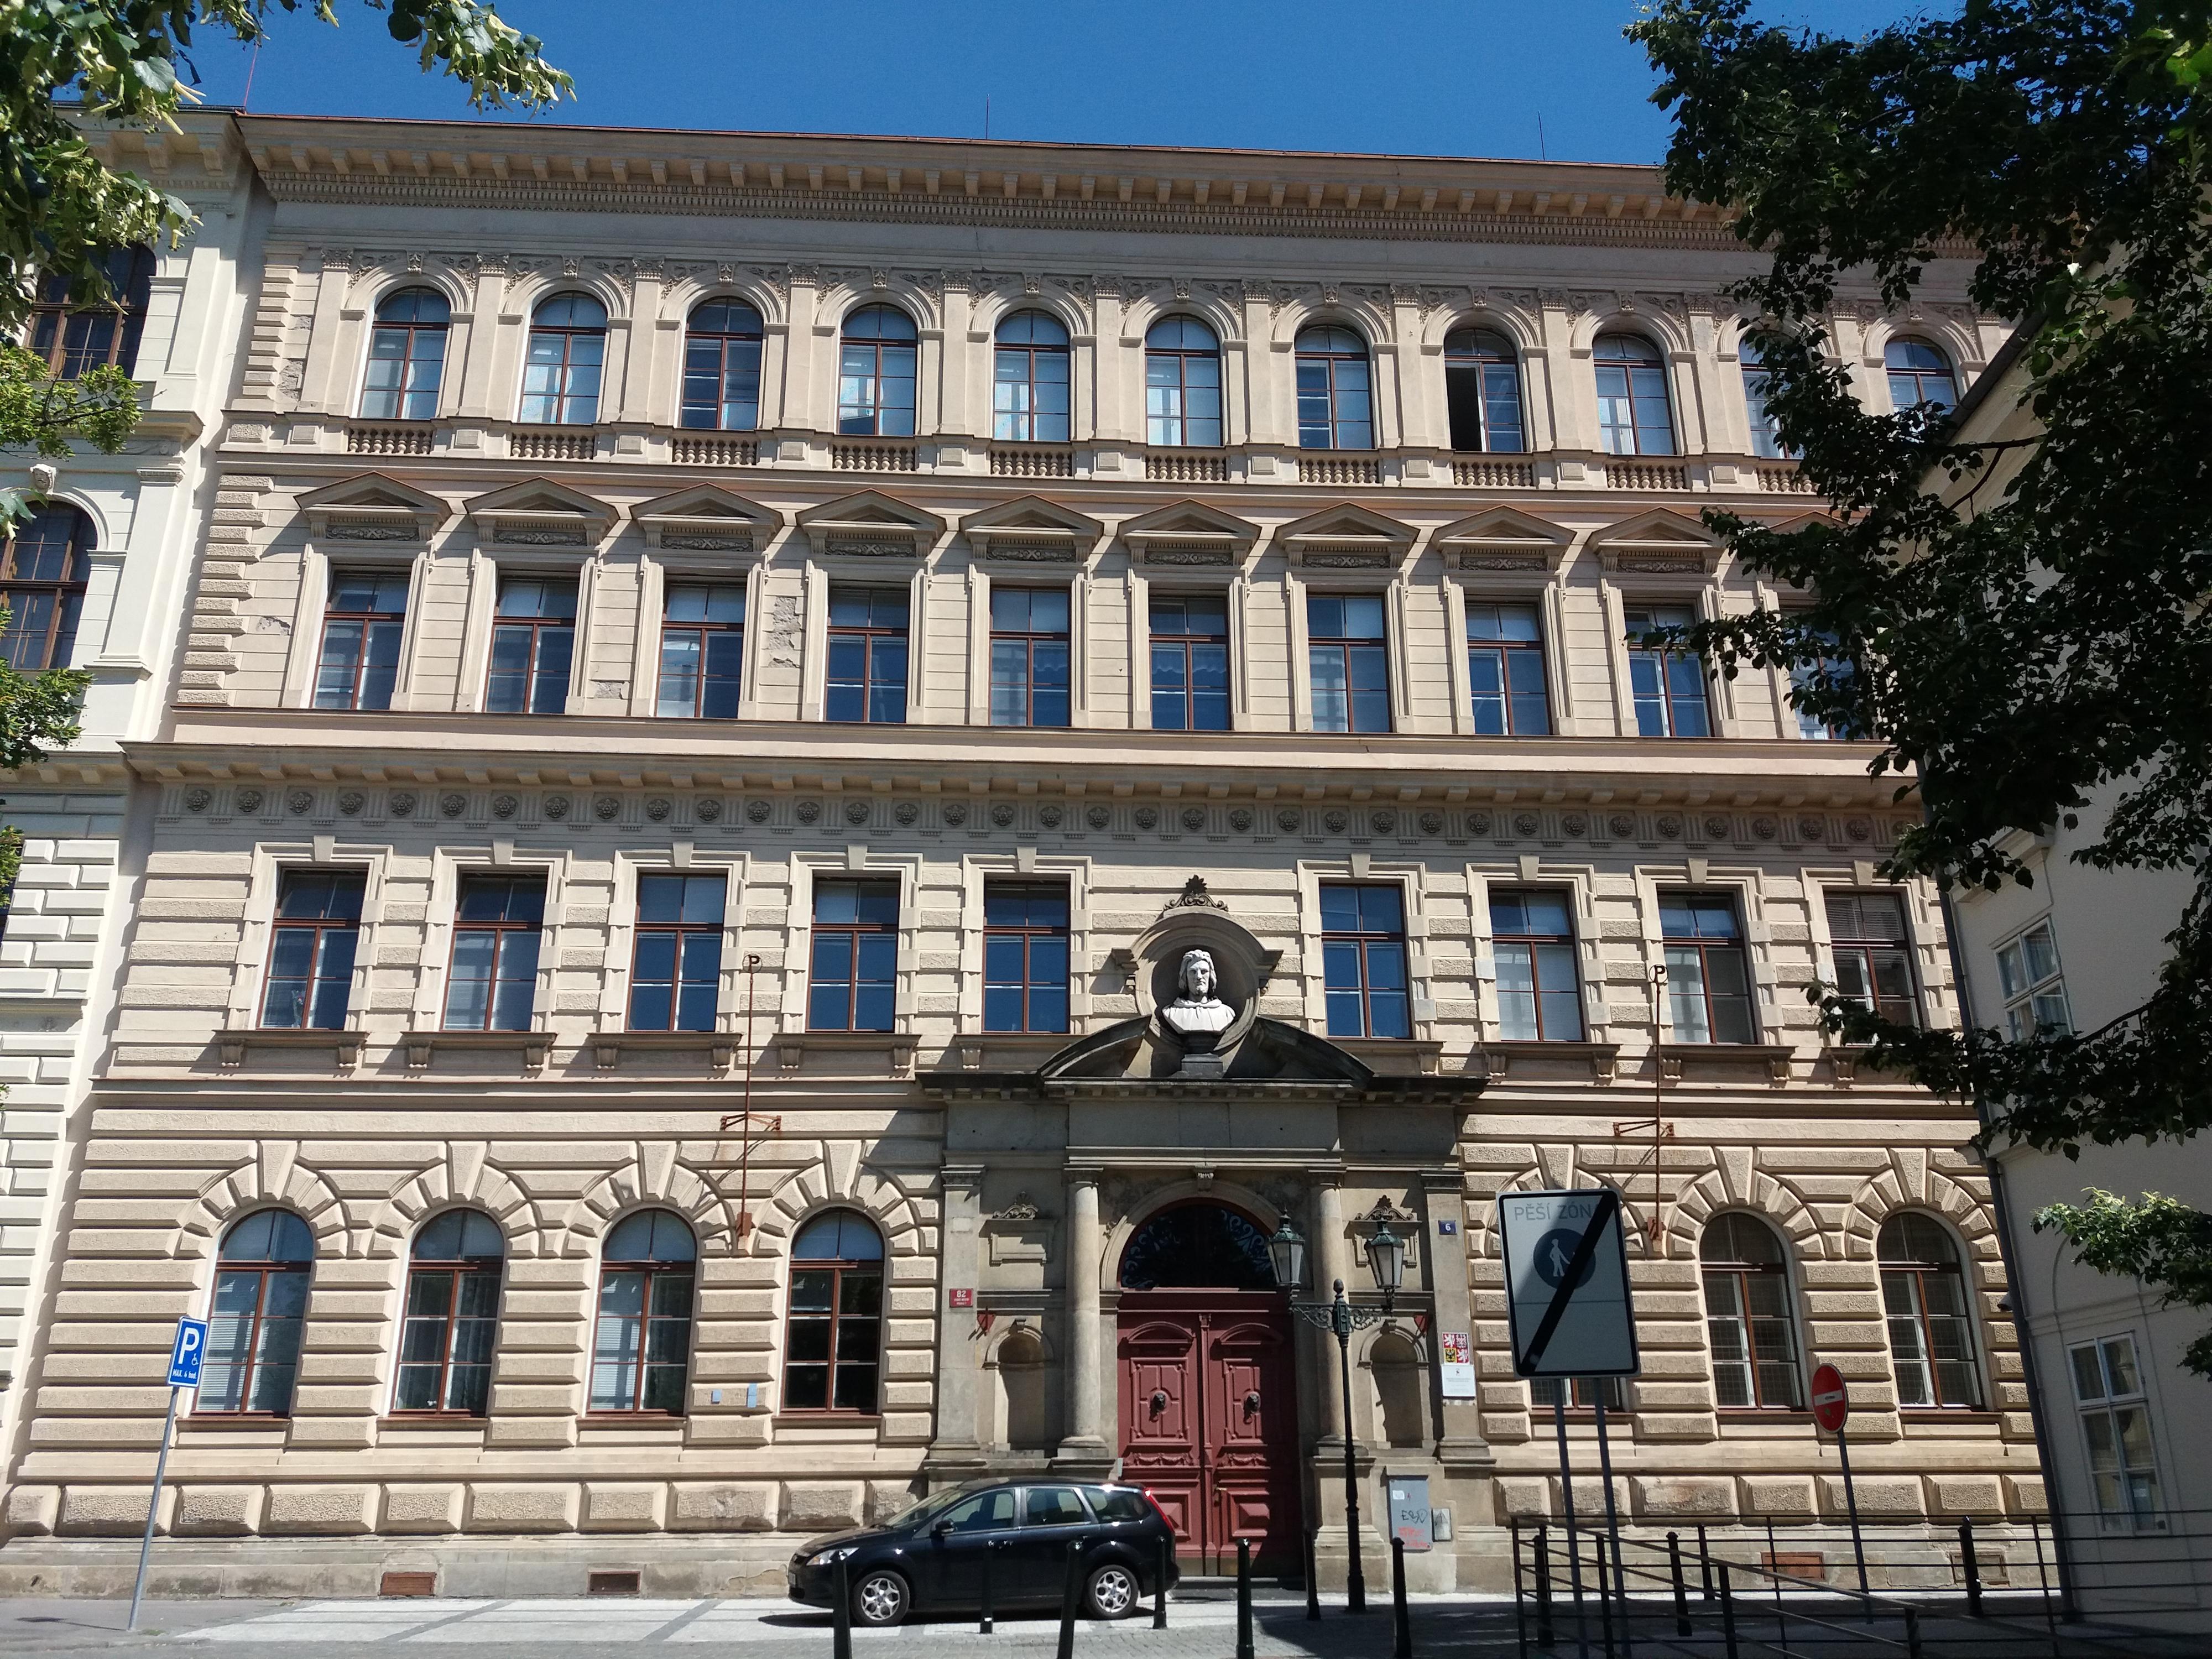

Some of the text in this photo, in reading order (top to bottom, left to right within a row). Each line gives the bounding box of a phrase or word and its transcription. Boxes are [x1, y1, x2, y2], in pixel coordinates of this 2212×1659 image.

[1514, 1201, 1599, 1221] PĚŠÍ ZÓN
[1445, 1223, 1452, 1232] 6
[956, 1290, 967, 1298] 82
[178, 1327, 200, 1364] P
